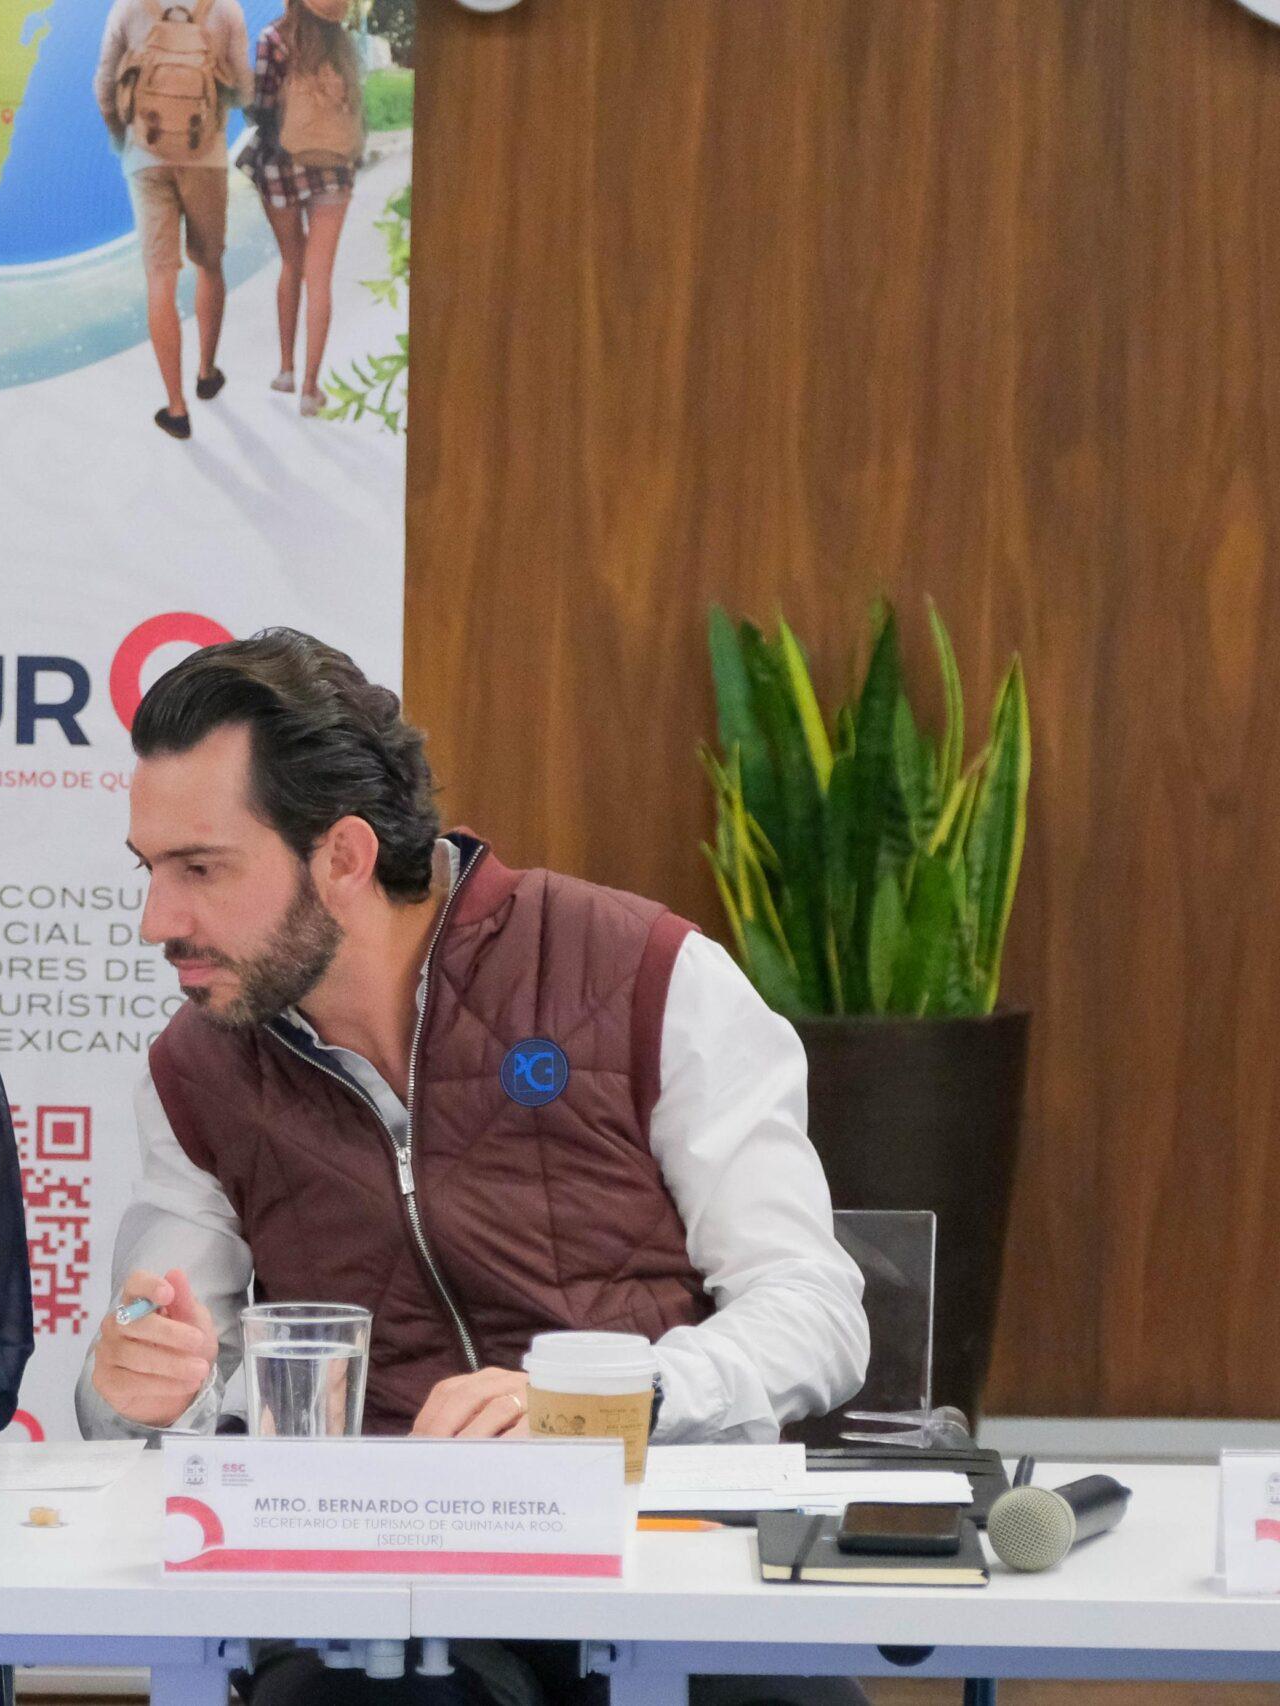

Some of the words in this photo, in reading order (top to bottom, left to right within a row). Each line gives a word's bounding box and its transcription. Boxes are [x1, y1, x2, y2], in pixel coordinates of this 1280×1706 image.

[62, 770, 93, 789] DE
[105, 958, 156, 983] DE
[254, 1497, 311, 1512] MTRO.
[318, 1498, 419, 1514] BERNARDO
[424, 1499, 486, 1515] CUETO
[491, 1500, 566, 1516] RIESTRA.
[253, 1517, 338, 1530] SECRETARIO
[342, 1518, 361, 1530] DE
[365, 1518, 425, 1531] TURISMO
[429, 1519, 448, 1531] DE
[451, 1519, 526, 1532] QUINTANA
[376, 1534, 444, 1548] (SEDETUR)
